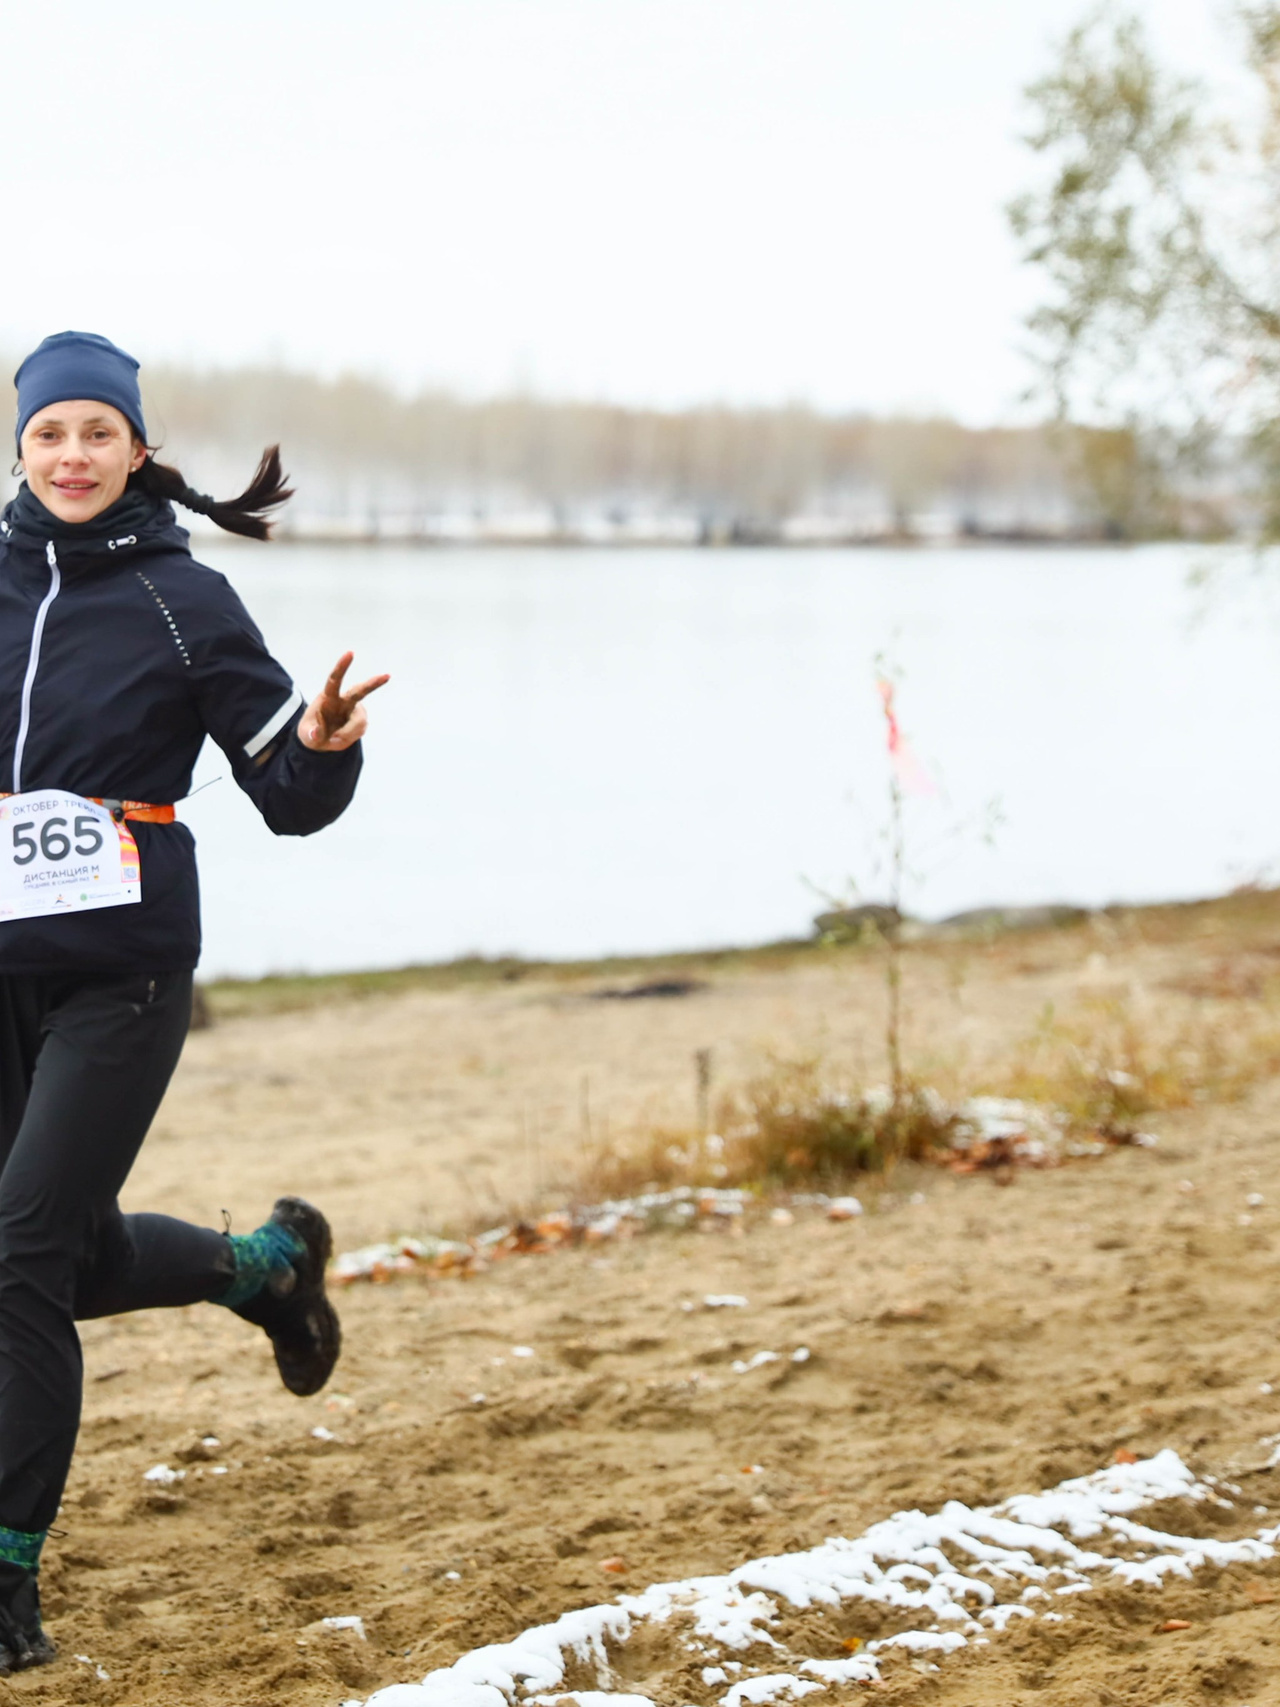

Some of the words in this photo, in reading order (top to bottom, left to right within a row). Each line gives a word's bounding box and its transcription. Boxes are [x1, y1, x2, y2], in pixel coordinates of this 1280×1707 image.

[12, 800, 59, 816] ОКТОБЕР
[13, 815, 103, 865] 565
[23, 866, 89, 884] ДИСТАНЦИЯ
